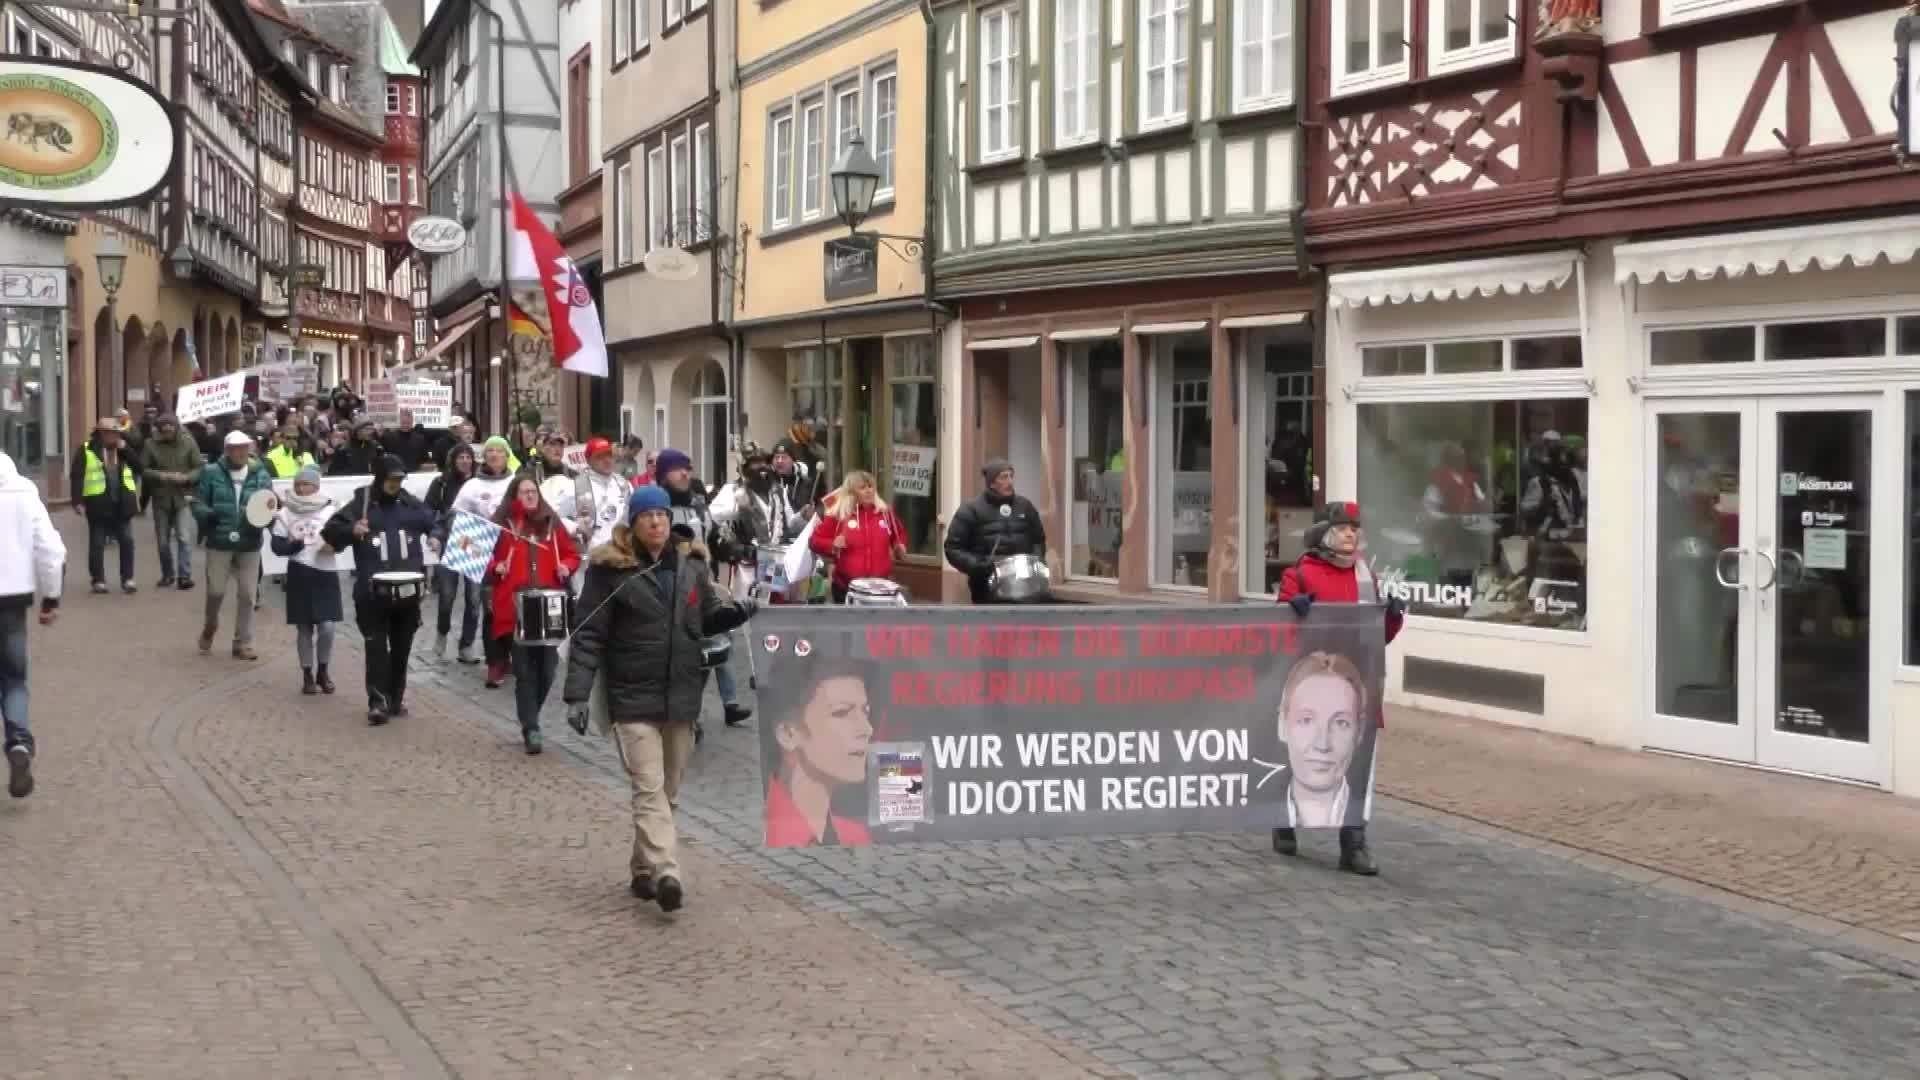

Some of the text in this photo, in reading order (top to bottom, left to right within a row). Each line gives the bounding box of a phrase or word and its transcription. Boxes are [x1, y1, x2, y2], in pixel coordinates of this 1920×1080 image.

[195, 382, 230, 398] NEIN
[865, 618, 1299, 658] WIR HABEN DIE DÜMMSTE
[891, 666, 1257, 705] REGIERUNG EUROPAS!
[932, 729, 1249, 769] WIR WERDEN VON
[948, 779, 1087, 816] IDIOTEN
[1101, 774, 1249, 811] REGIERT!
